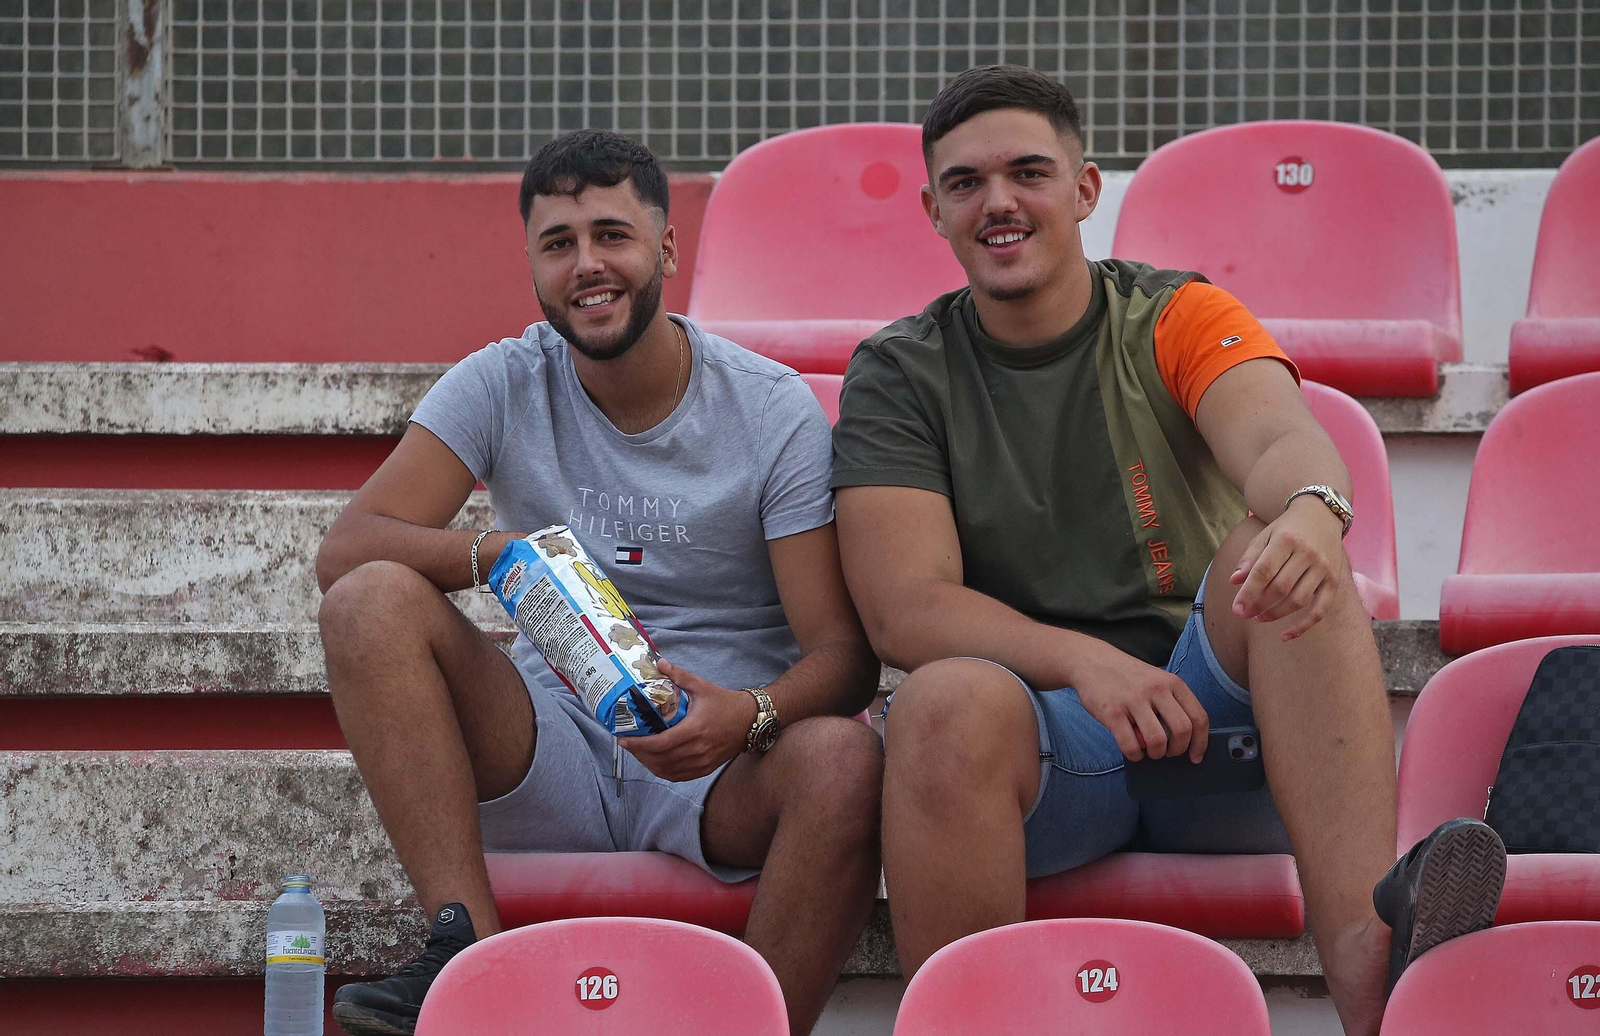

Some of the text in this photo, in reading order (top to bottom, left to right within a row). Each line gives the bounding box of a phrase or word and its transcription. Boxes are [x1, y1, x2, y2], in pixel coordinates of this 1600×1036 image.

[1275, 162, 1314, 187] 130
[578, 487, 682, 518] TOMMY
[568, 508, 691, 544] HILFIGER
[1128, 458, 1174, 595] TOMMY JEANS
[576, 974, 618, 1000] 126
[1077, 967, 1118, 993] 124
